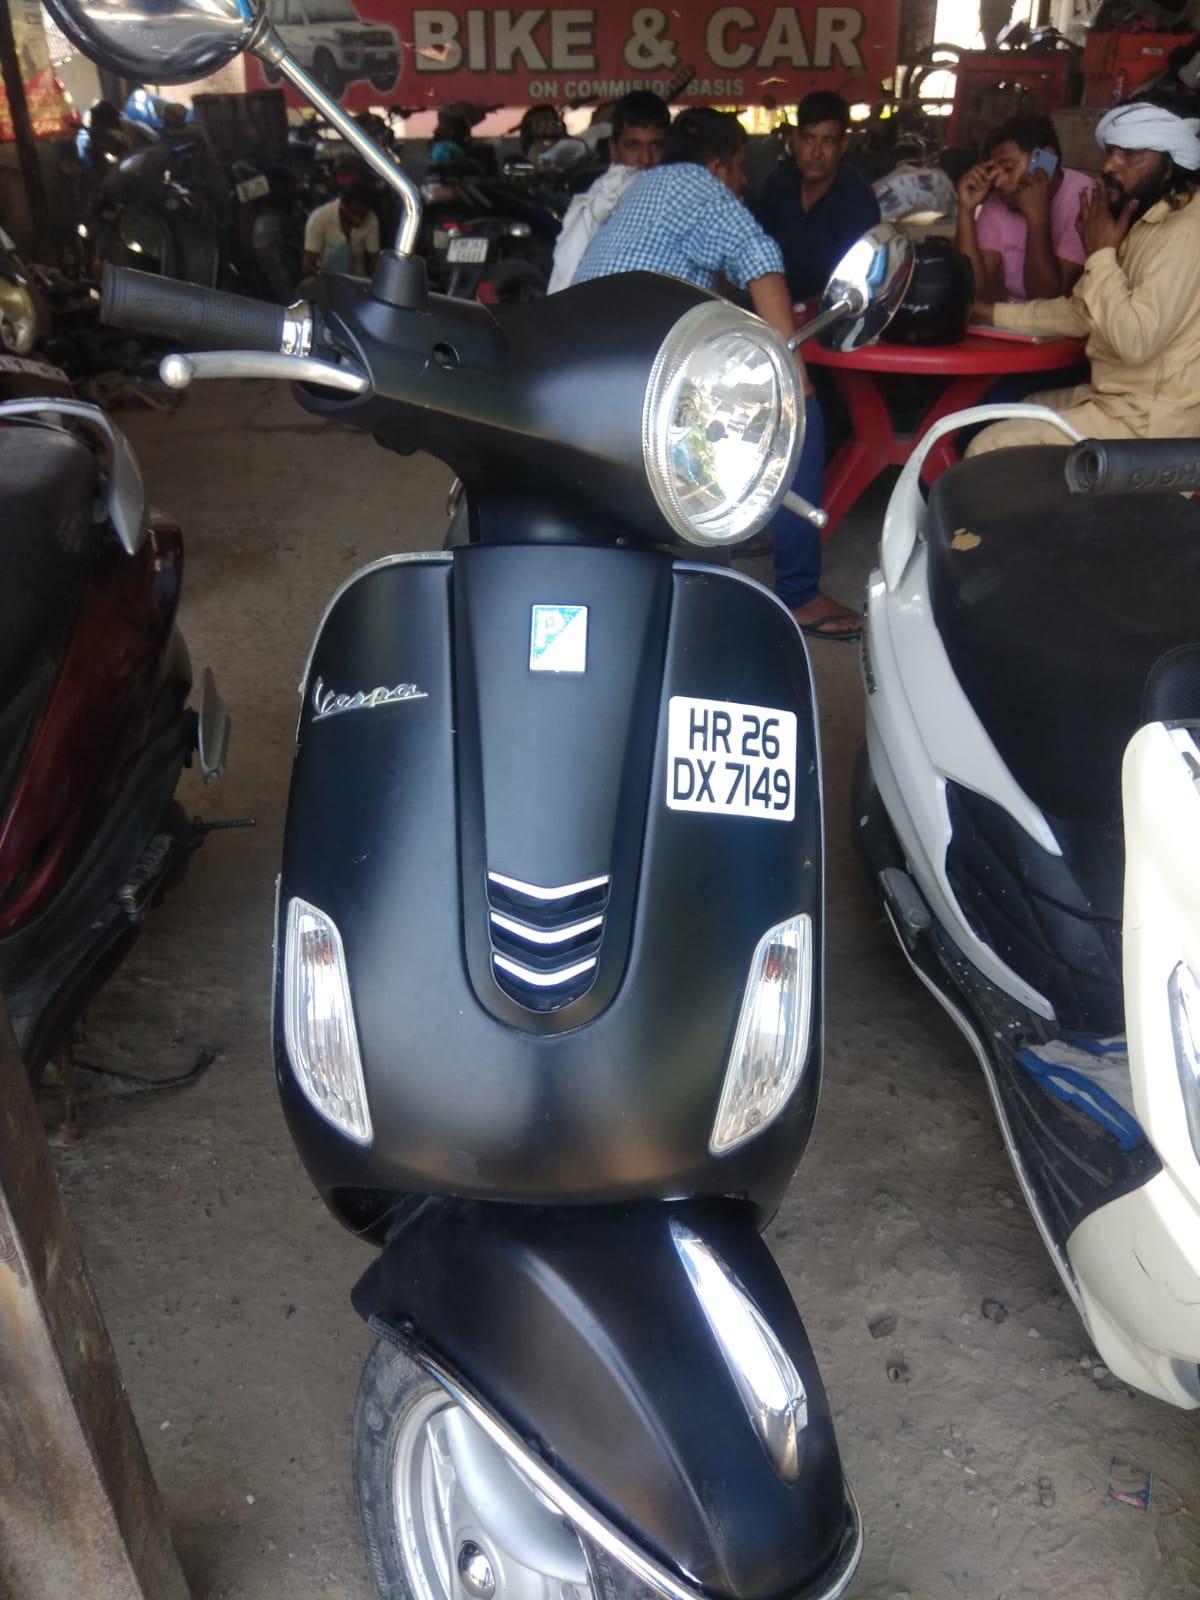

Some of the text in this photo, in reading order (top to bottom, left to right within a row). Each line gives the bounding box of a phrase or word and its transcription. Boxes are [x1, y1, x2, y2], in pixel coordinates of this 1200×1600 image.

[412, 6, 865, 71] BIKE & CAR
[529, 80, 558, 97] ON
[686, 79, 744, 96] BASIS
[312, 676, 426, 720] Vespa
[689, 707, 780, 760] HR 26
[673, 757, 791, 811] DX 7149
